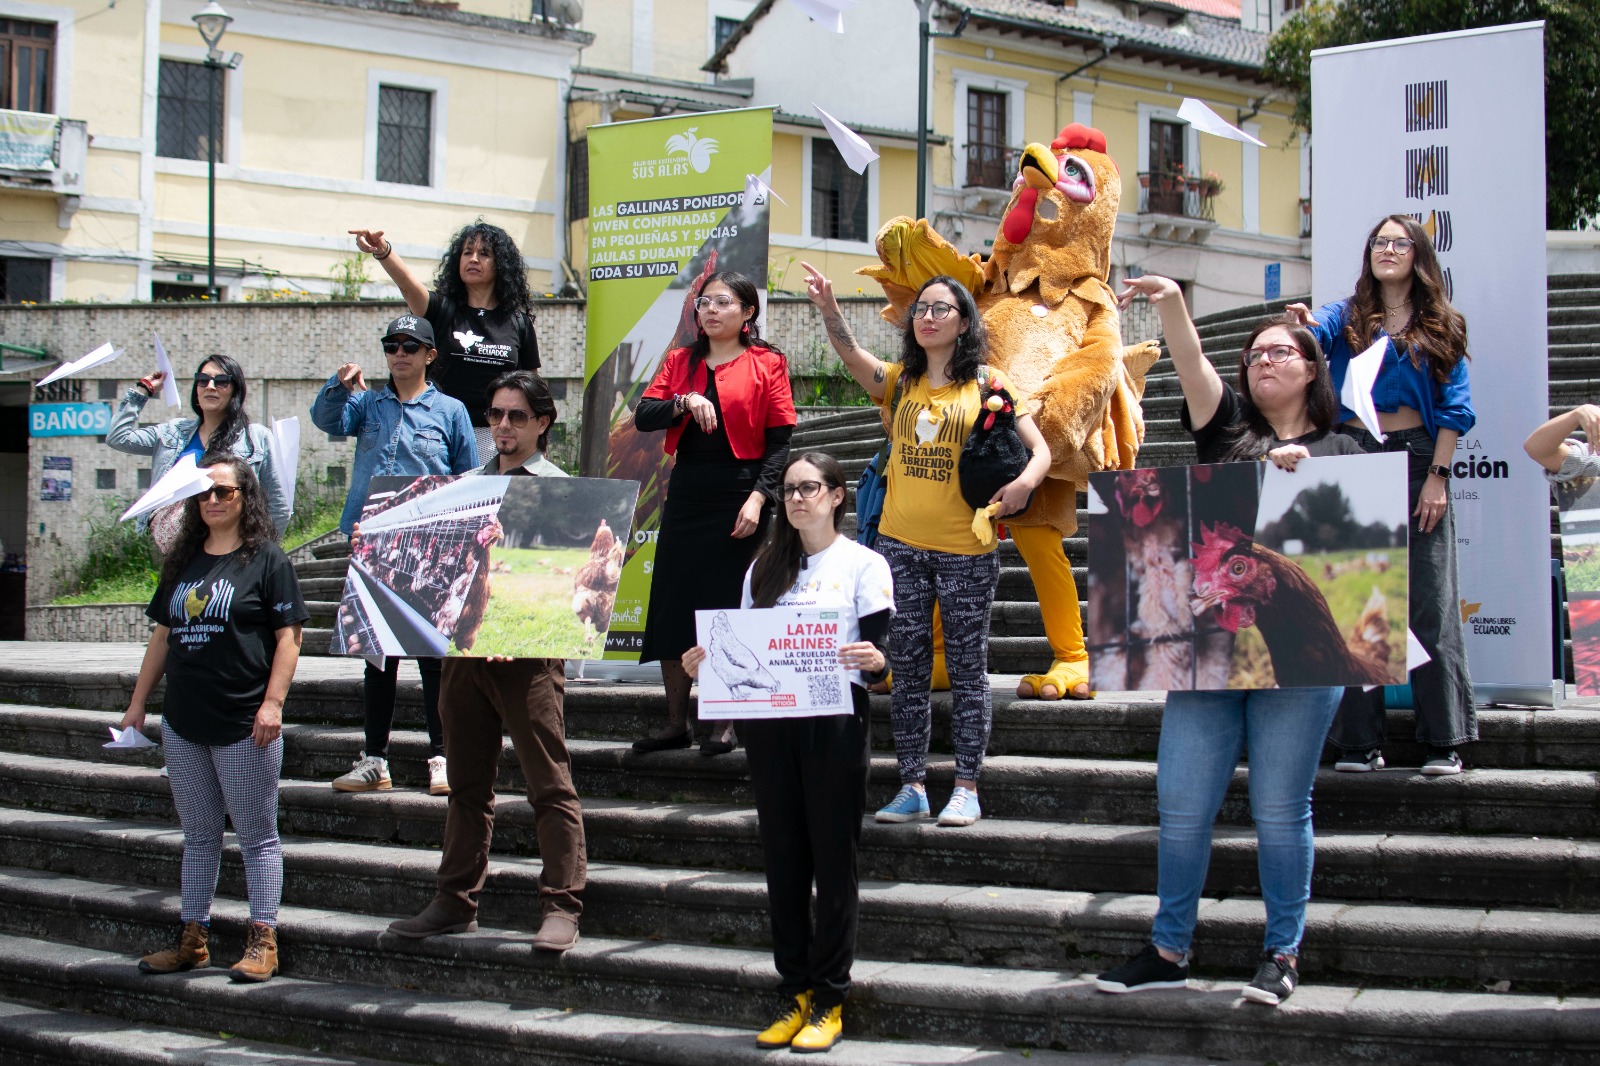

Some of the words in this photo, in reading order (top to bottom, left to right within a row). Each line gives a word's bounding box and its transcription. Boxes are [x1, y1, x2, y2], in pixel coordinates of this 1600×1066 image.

[632, 166, 655, 180] SUS
[658, 162, 689, 177] ALAS
[593, 204, 614, 218] LAS
[617, 199, 680, 215] GALLINAS
[683, 193, 765, 210] PONEDORS
[592, 218, 629, 233] VIVEN
[632, 211, 717, 230] CONFINADAS
[592, 236, 606, 249] EN
[610, 229, 678, 247] PEQUEÑAS
[682, 230, 691, 242] Y
[694, 225, 738, 241] SUCIAS
[591, 249, 636, 265] JAULAS
[639, 245, 700, 261] DURANTE
[590, 266, 623, 280] TODA
[626, 264, 643, 277] SU
[646, 262, 678, 276] VIDA
[478, 347, 509, 358] ECUADOR
[32, 406, 107, 431] BAÑOS
[1466, 439, 1482, 450] LA
[900, 455, 954, 470] ABRIENDO
[1449, 454, 1509, 479] ción
[904, 465, 952, 485] JAULAS!
[1453, 489, 1480, 500] ulas.
[1469, 616, 1497, 625] GALLINAS
[1498, 617, 1516, 625] LIBRES
[190, 624, 225, 633] ABRIENDO
[787, 623, 838, 636] LATAM
[1473, 624, 1511, 635] ECUADOR
[768, 637, 837, 650] AIRLINES:
[796, 650, 836, 658] CRUELDAD
[795, 664, 812, 673] MÁS
